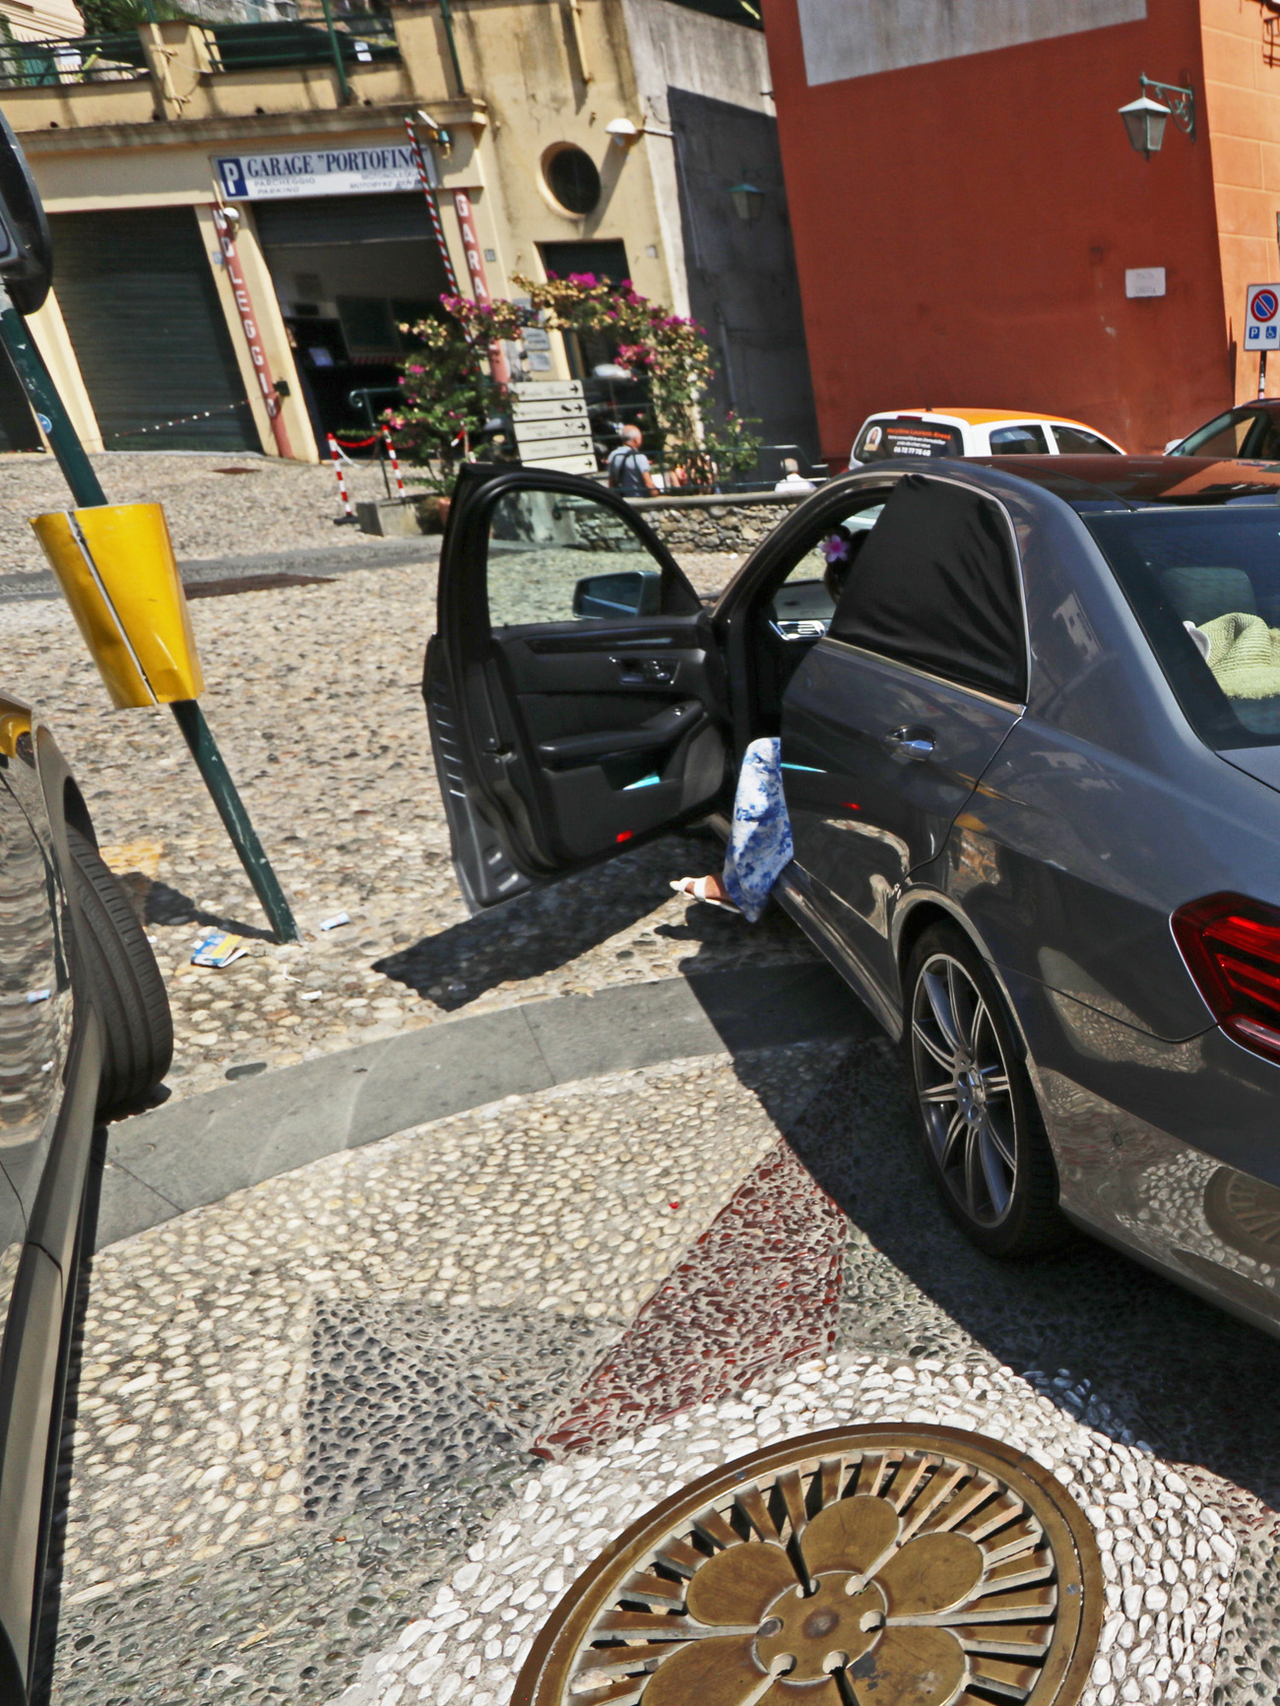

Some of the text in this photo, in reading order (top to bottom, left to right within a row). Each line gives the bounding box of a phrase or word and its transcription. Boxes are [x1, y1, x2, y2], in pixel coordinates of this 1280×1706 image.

[222, 161, 238, 194] P
[247, 154, 314, 178] GARAGE
[213, 209, 277, 418] NOLEGGIO
[1251, 328, 1259, 338] P
